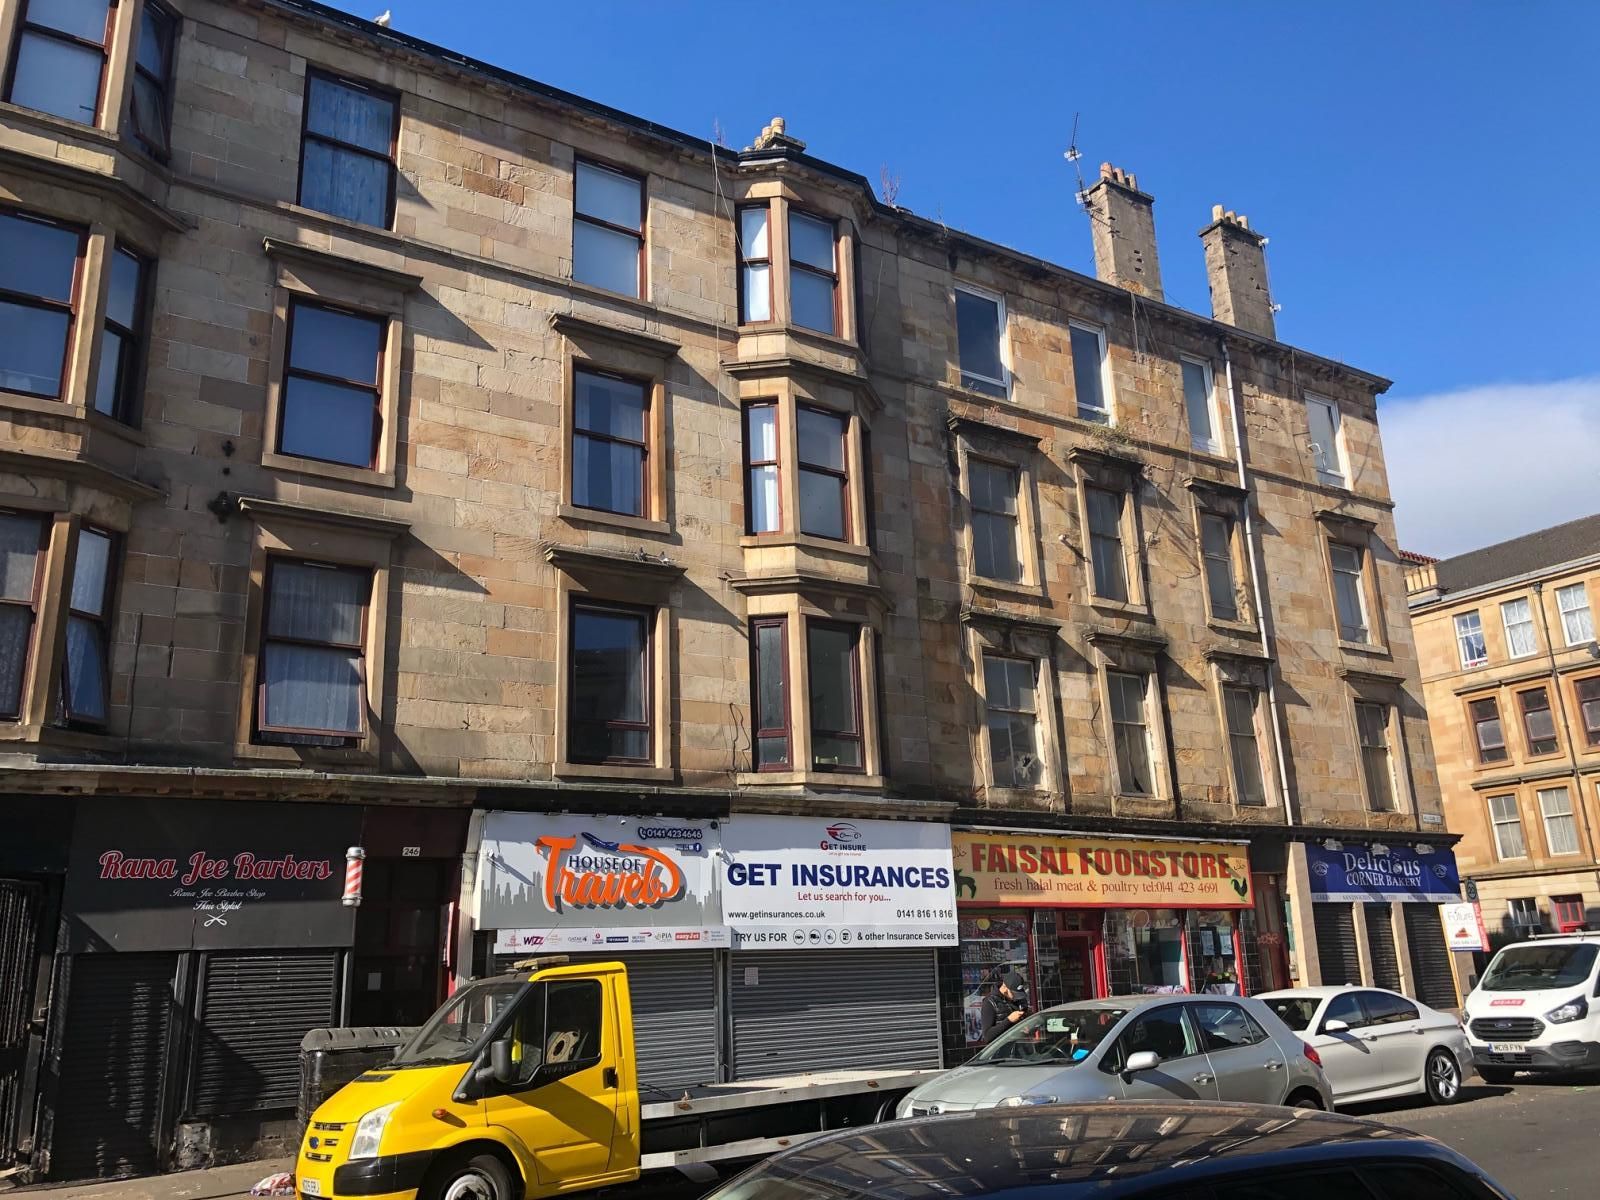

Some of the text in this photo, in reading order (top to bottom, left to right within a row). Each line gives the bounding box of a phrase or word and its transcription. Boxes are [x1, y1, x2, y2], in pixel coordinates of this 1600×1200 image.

[404, 848, 419, 856] 246
[99, 850, 333, 886] Rana Jee Barbers
[569, 855, 641, 870] HOUSE OF
[971, 843, 1232, 879] FAISAL FOODSTORE
[727, 863, 950, 889] GET INSURANCES
[1346, 871, 1422, 887] CORNER BAKERY
[994, 877, 1022, 890] fresh
[1026, 879, 1052, 891] halal
[1056, 881, 1083, 891] meat
[1087, 880, 1097, 892] &
[1101, 881, 1139, 895] poultry
[1178, 883, 1195, 893] 423
[1198, 883, 1218, 893] 4691
[798, 892, 812, 901] Let
[813, 894, 824, 902] us
[825, 892, 852, 902] search
[854, 892, 868, 902] for
[728, 910, 953, 919] www.getinsurances.co.uk 0141 816 1 816
[734, 933, 752, 942] TRY
[754, 933, 767, 942] US
[769, 933, 787, 942] FOR
[857, 932, 863, 940] &
[865, 932, 885, 941] other
[887, 932, 922, 940] Insurance
[924, 931, 955, 940] Services
